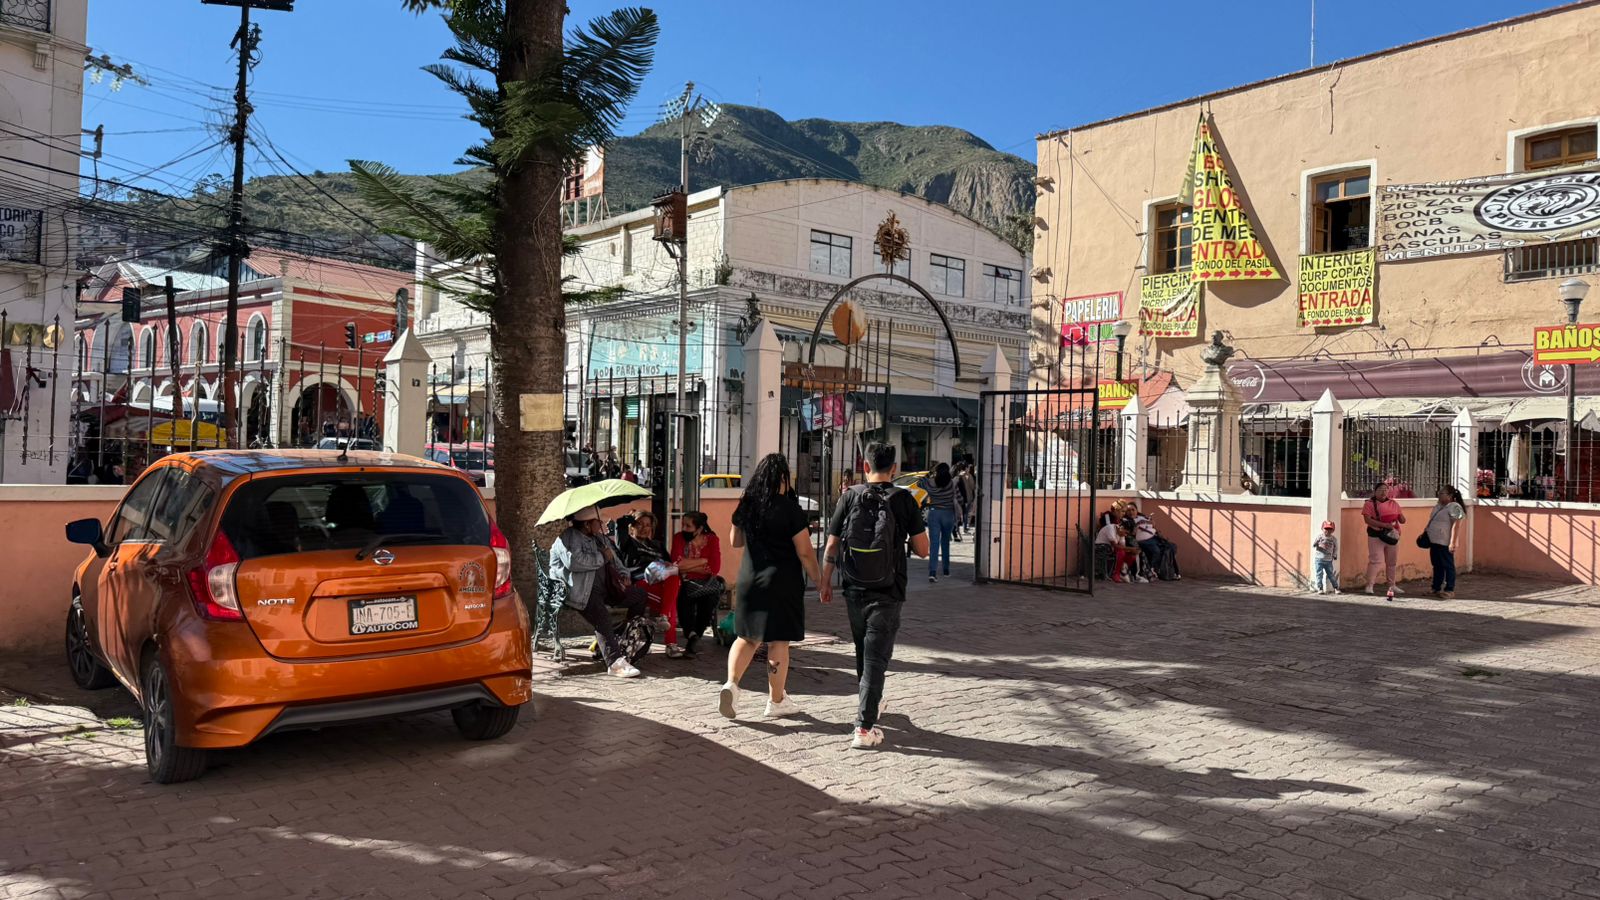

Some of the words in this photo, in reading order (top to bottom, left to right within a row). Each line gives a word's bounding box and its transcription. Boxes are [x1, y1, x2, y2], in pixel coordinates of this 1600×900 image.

[1383, 201, 1418, 212] ZIG
[1425, 195, 1473, 207] ZAG
[1384, 206, 1464, 221] BONGS
[1395, 218, 1443, 229] OCB
[1193, 225, 1214, 242] DE
[1382, 226, 1460, 241] CANAS
[1377, 232, 1501, 252] BASCULAS
[1384, 240, 1526, 260] MENUDEO
[1225, 259, 1243, 268] DEL
[1301, 270, 1328, 282] CURP
[1331, 265, 1370, 279] COPIAS
[1301, 277, 1373, 293] DOCUMENTOS
[1299, 288, 1372, 311] ENTRADA
[1065, 296, 1119, 323] PAPELERIA
[1307, 310, 1329, 319] FONDO
[1331, 309, 1343, 317] DEL
[1345, 307, 1372, 316] PASILLO
[616, 364, 636, 376] PARA
[900, 415, 961, 425] TRIPILLOS
[257, 597, 296, 606] NOTE
[366, 621, 418, 633] AUTOCOM
